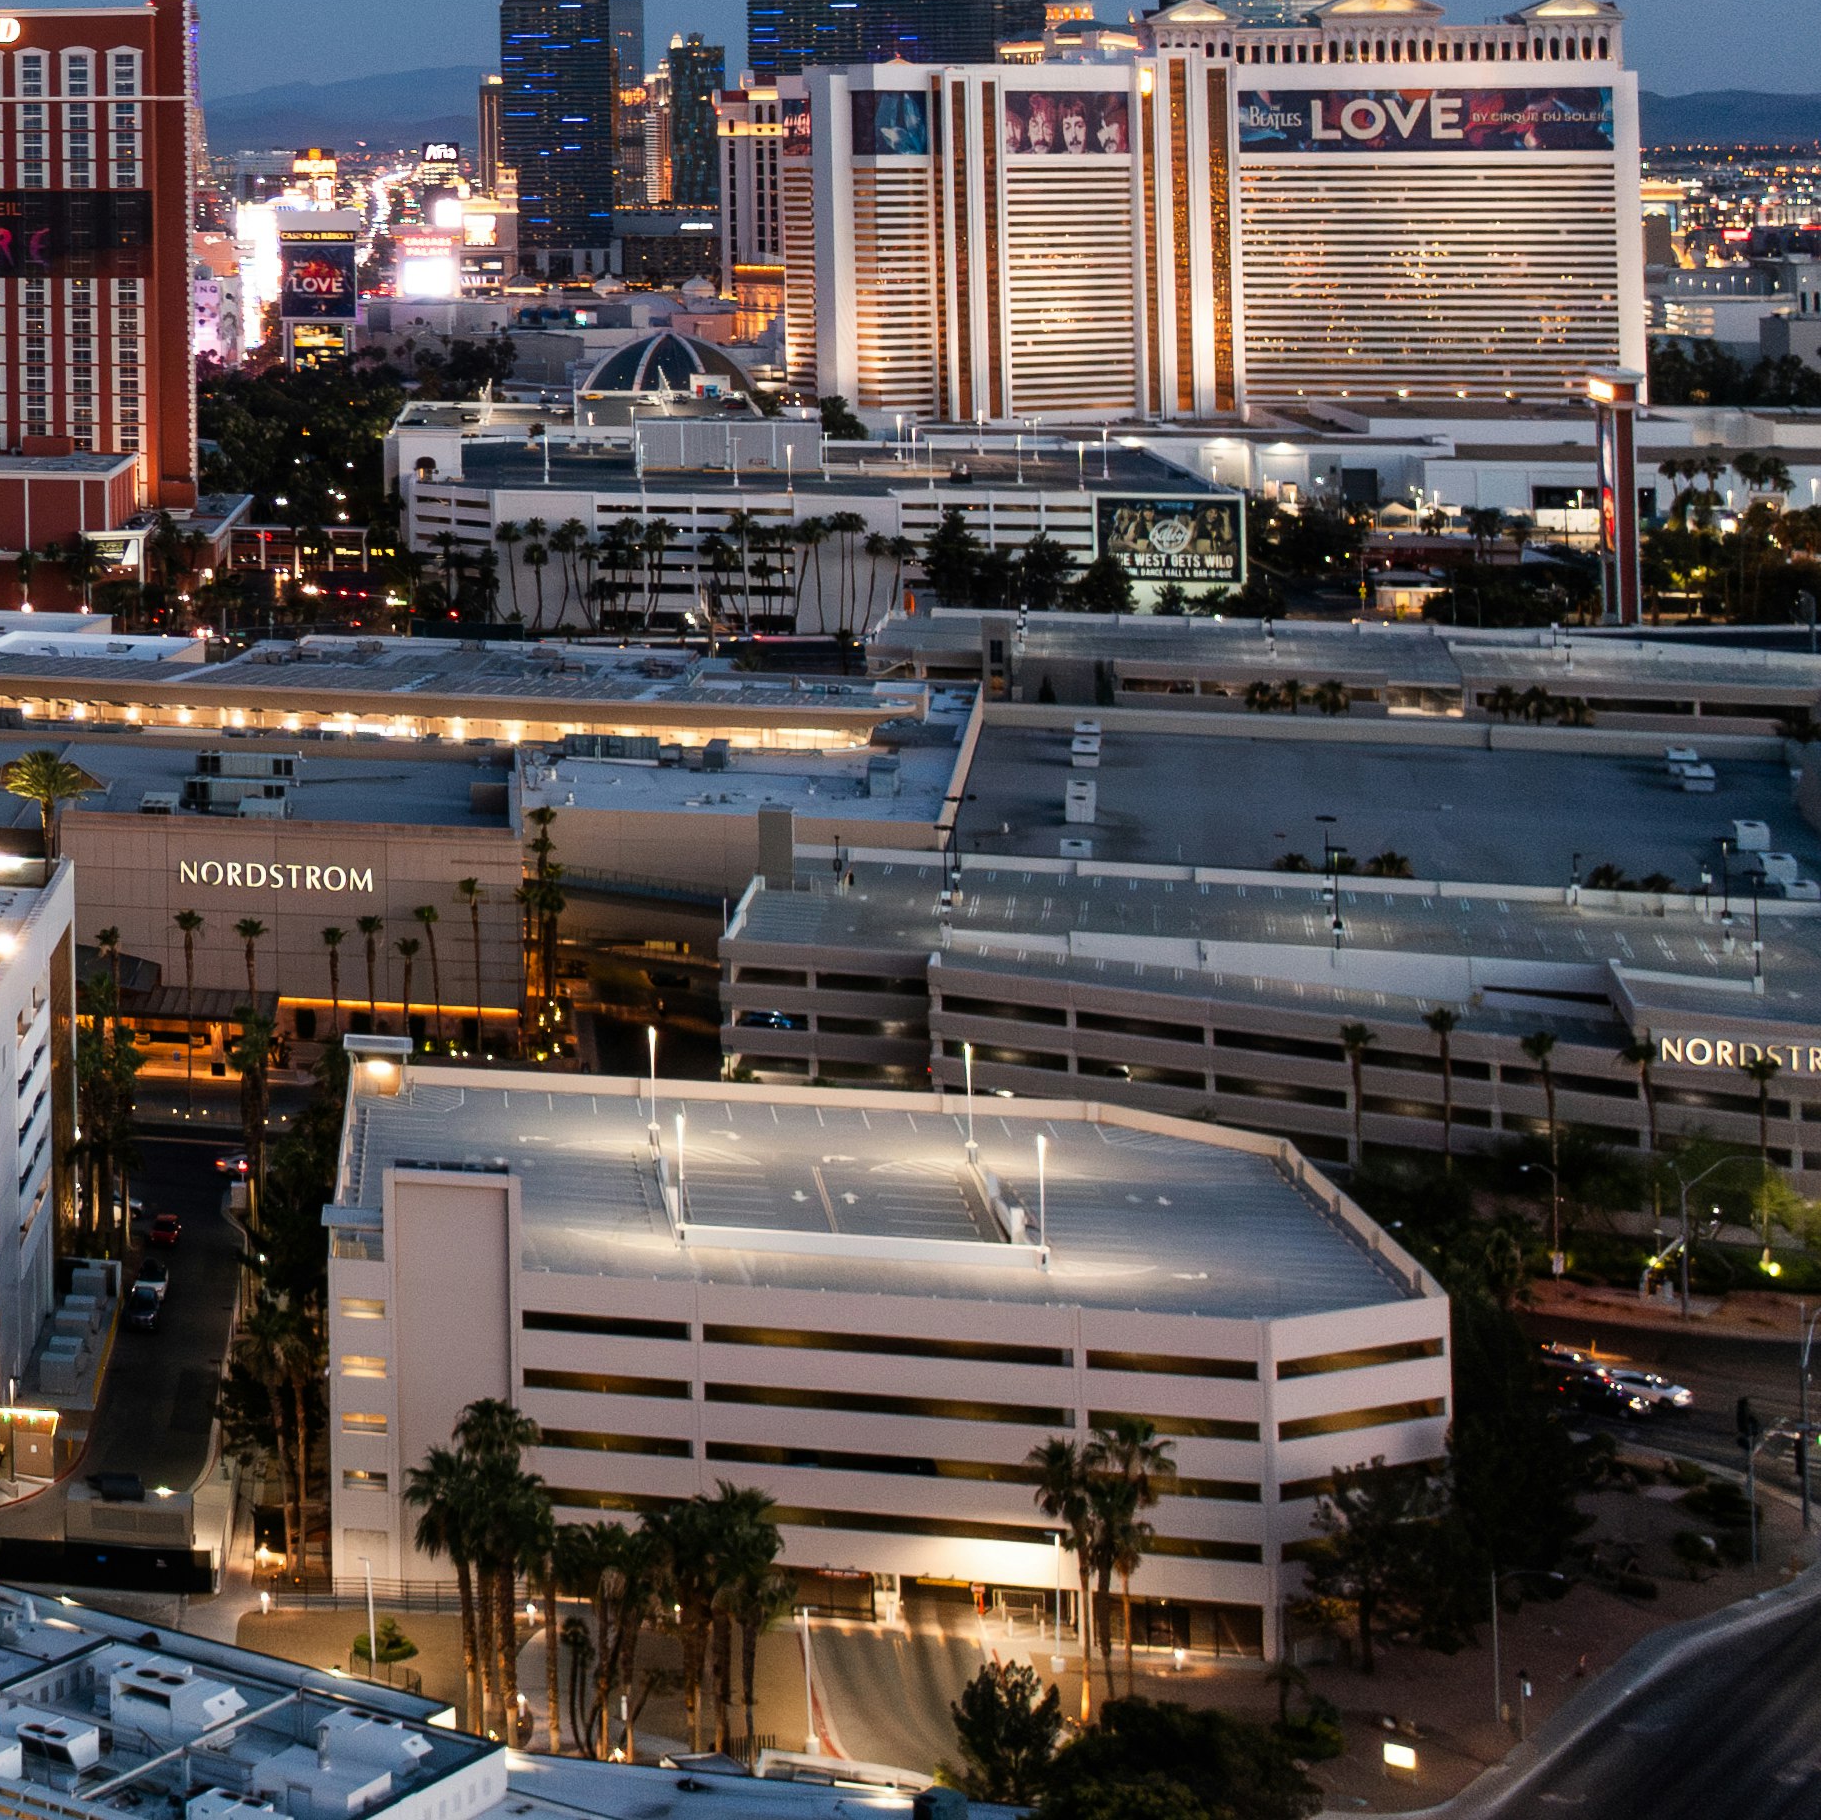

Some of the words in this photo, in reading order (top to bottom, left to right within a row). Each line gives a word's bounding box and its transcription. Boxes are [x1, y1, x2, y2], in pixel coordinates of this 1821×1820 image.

[1311, 97, 1464, 140] LOVE
[1472, 111, 1488, 122] BY
[1491, 112, 1538, 123] CIRQUE
[1543, 112, 1561, 122] DU
[1565, 111, 1608, 121] SOLEIL
[293, 159, 337, 173] MGM
[292, 276, 344, 292] LOVE
[1134, 553, 1167, 567] WEST
[1171, 554, 1201, 568] GETS
[1205, 555, 1234, 569] WILD
[180, 860, 373, 893] NORDSTROM
